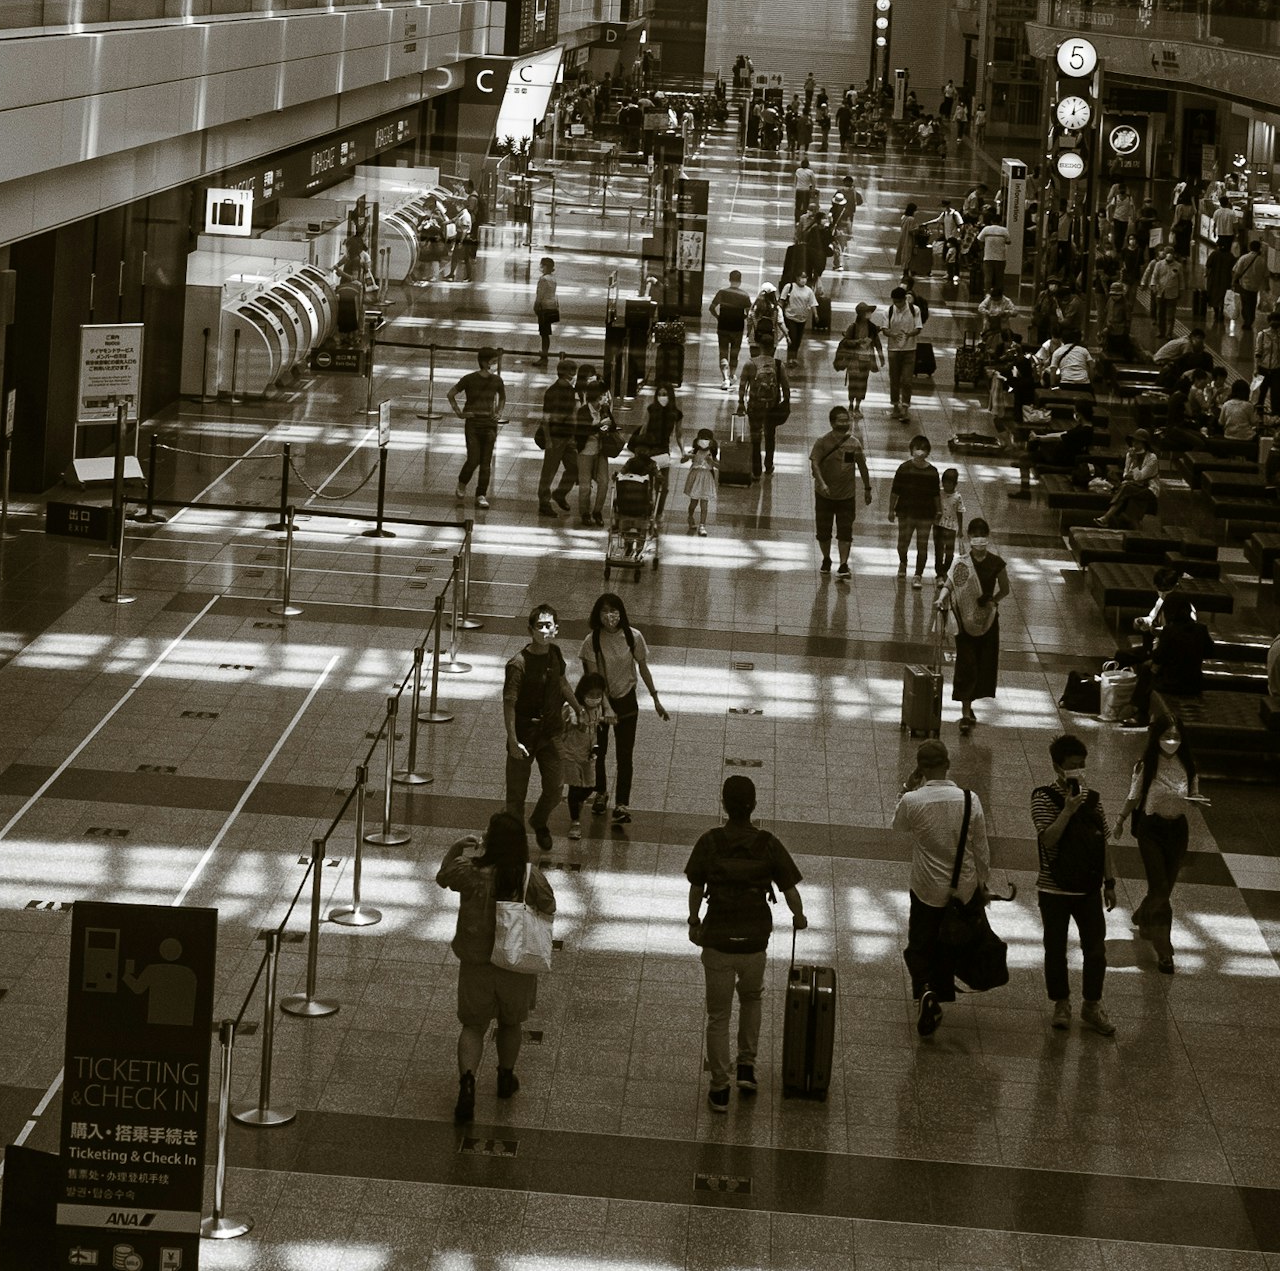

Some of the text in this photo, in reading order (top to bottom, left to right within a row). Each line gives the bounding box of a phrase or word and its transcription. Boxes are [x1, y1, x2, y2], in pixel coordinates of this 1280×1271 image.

[606, 29, 618, 43] D
[1069, 45, 1084, 70] 5
[476, 69, 494, 93] C
[520, 65, 533, 83] C
[240, 192, 249, 200] 11
[1012, 183, 1022, 222] Information
[69, 509, 90, 521] 出口
[68, 523, 89, 533] EXIT
[73, 1056, 199, 1086] TICKETING
[175, 1089, 199, 1112] IN
[70, 1122, 199, 1146] 購入・搭乗手続き
[69, 1146, 197, 1166] Ticketing & Check In
[105, 1212, 139, 1227] ANA
